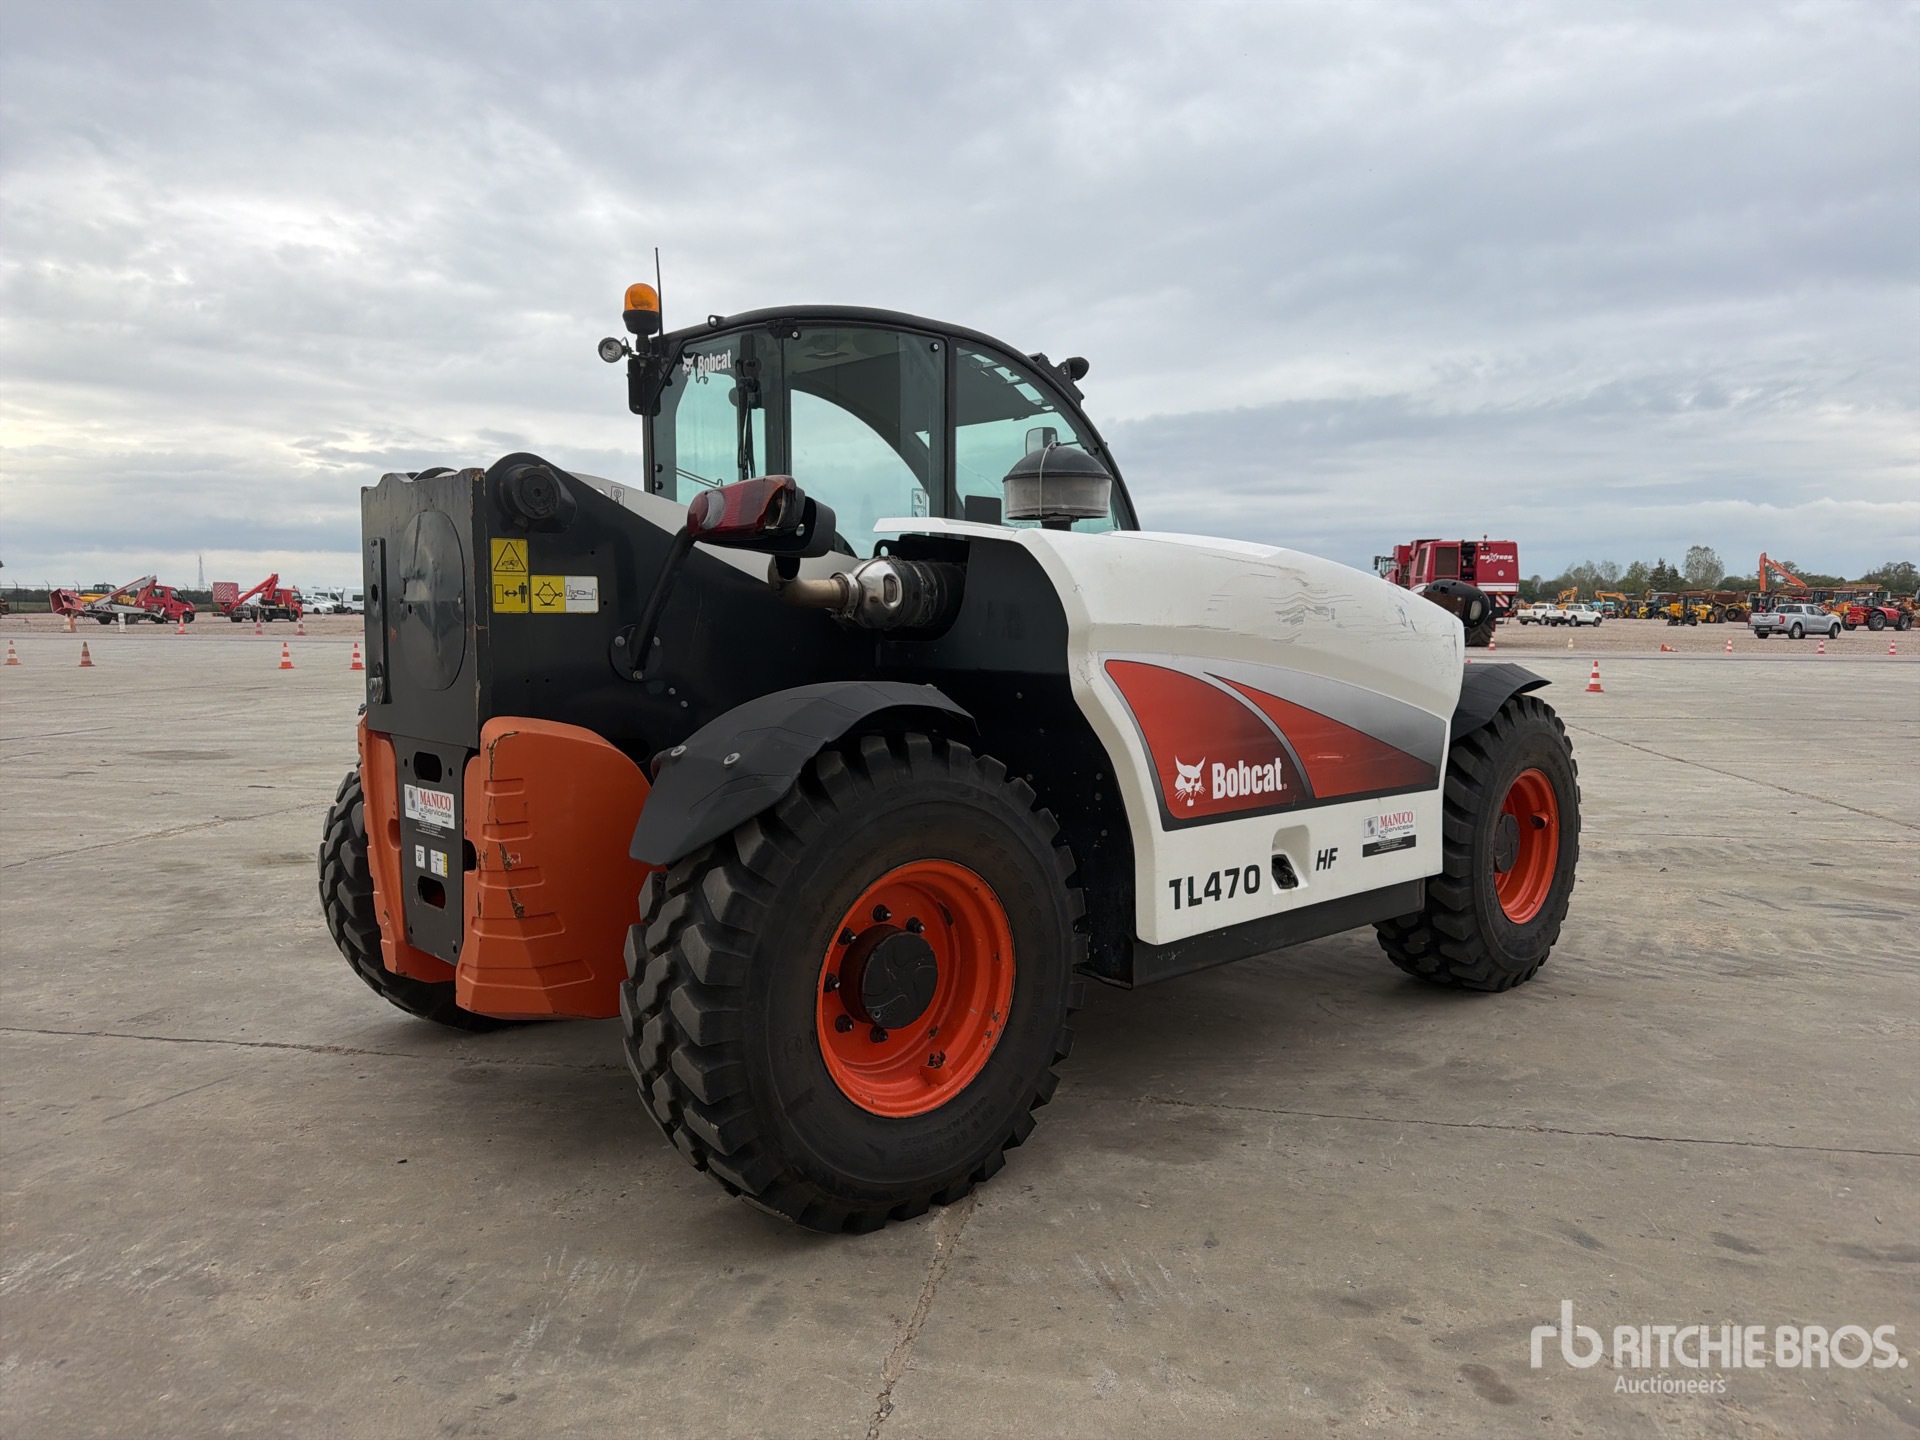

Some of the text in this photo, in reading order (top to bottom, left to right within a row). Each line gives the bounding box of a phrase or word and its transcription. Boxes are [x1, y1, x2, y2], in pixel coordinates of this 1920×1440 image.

[698, 349, 731, 376] Bobcat
[1212, 757, 1283, 800] Bobcat
[419, 790, 452, 812] MANUCO
[1380, 811, 1414, 828] MANUCO
[1315, 847, 1338, 871] HF
[1169, 864, 1261, 910] TL470
